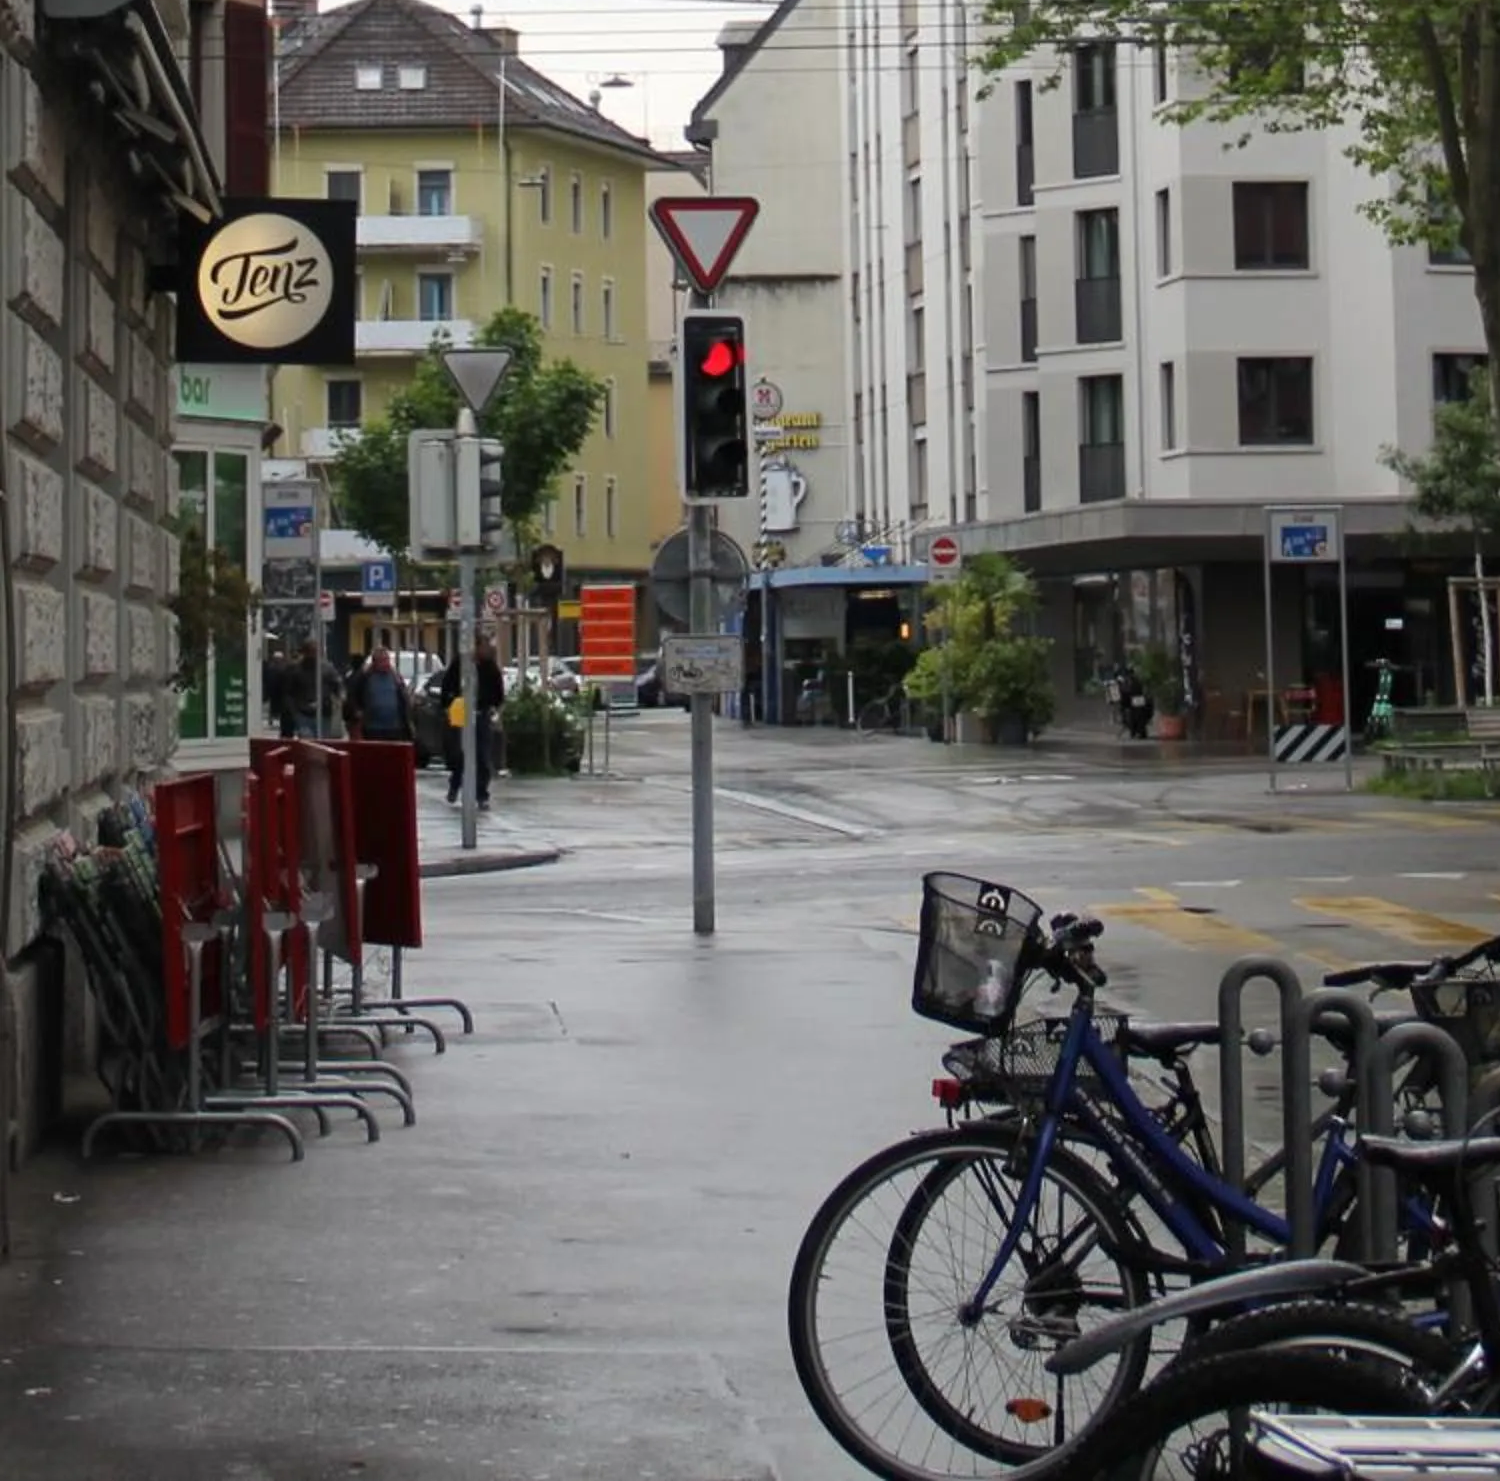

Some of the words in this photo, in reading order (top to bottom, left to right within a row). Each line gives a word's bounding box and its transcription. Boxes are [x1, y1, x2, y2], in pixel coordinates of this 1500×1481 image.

[210, 237, 320, 320] Tenz
[180, 366, 211, 405] bar
[369, 565, 386, 588] P
